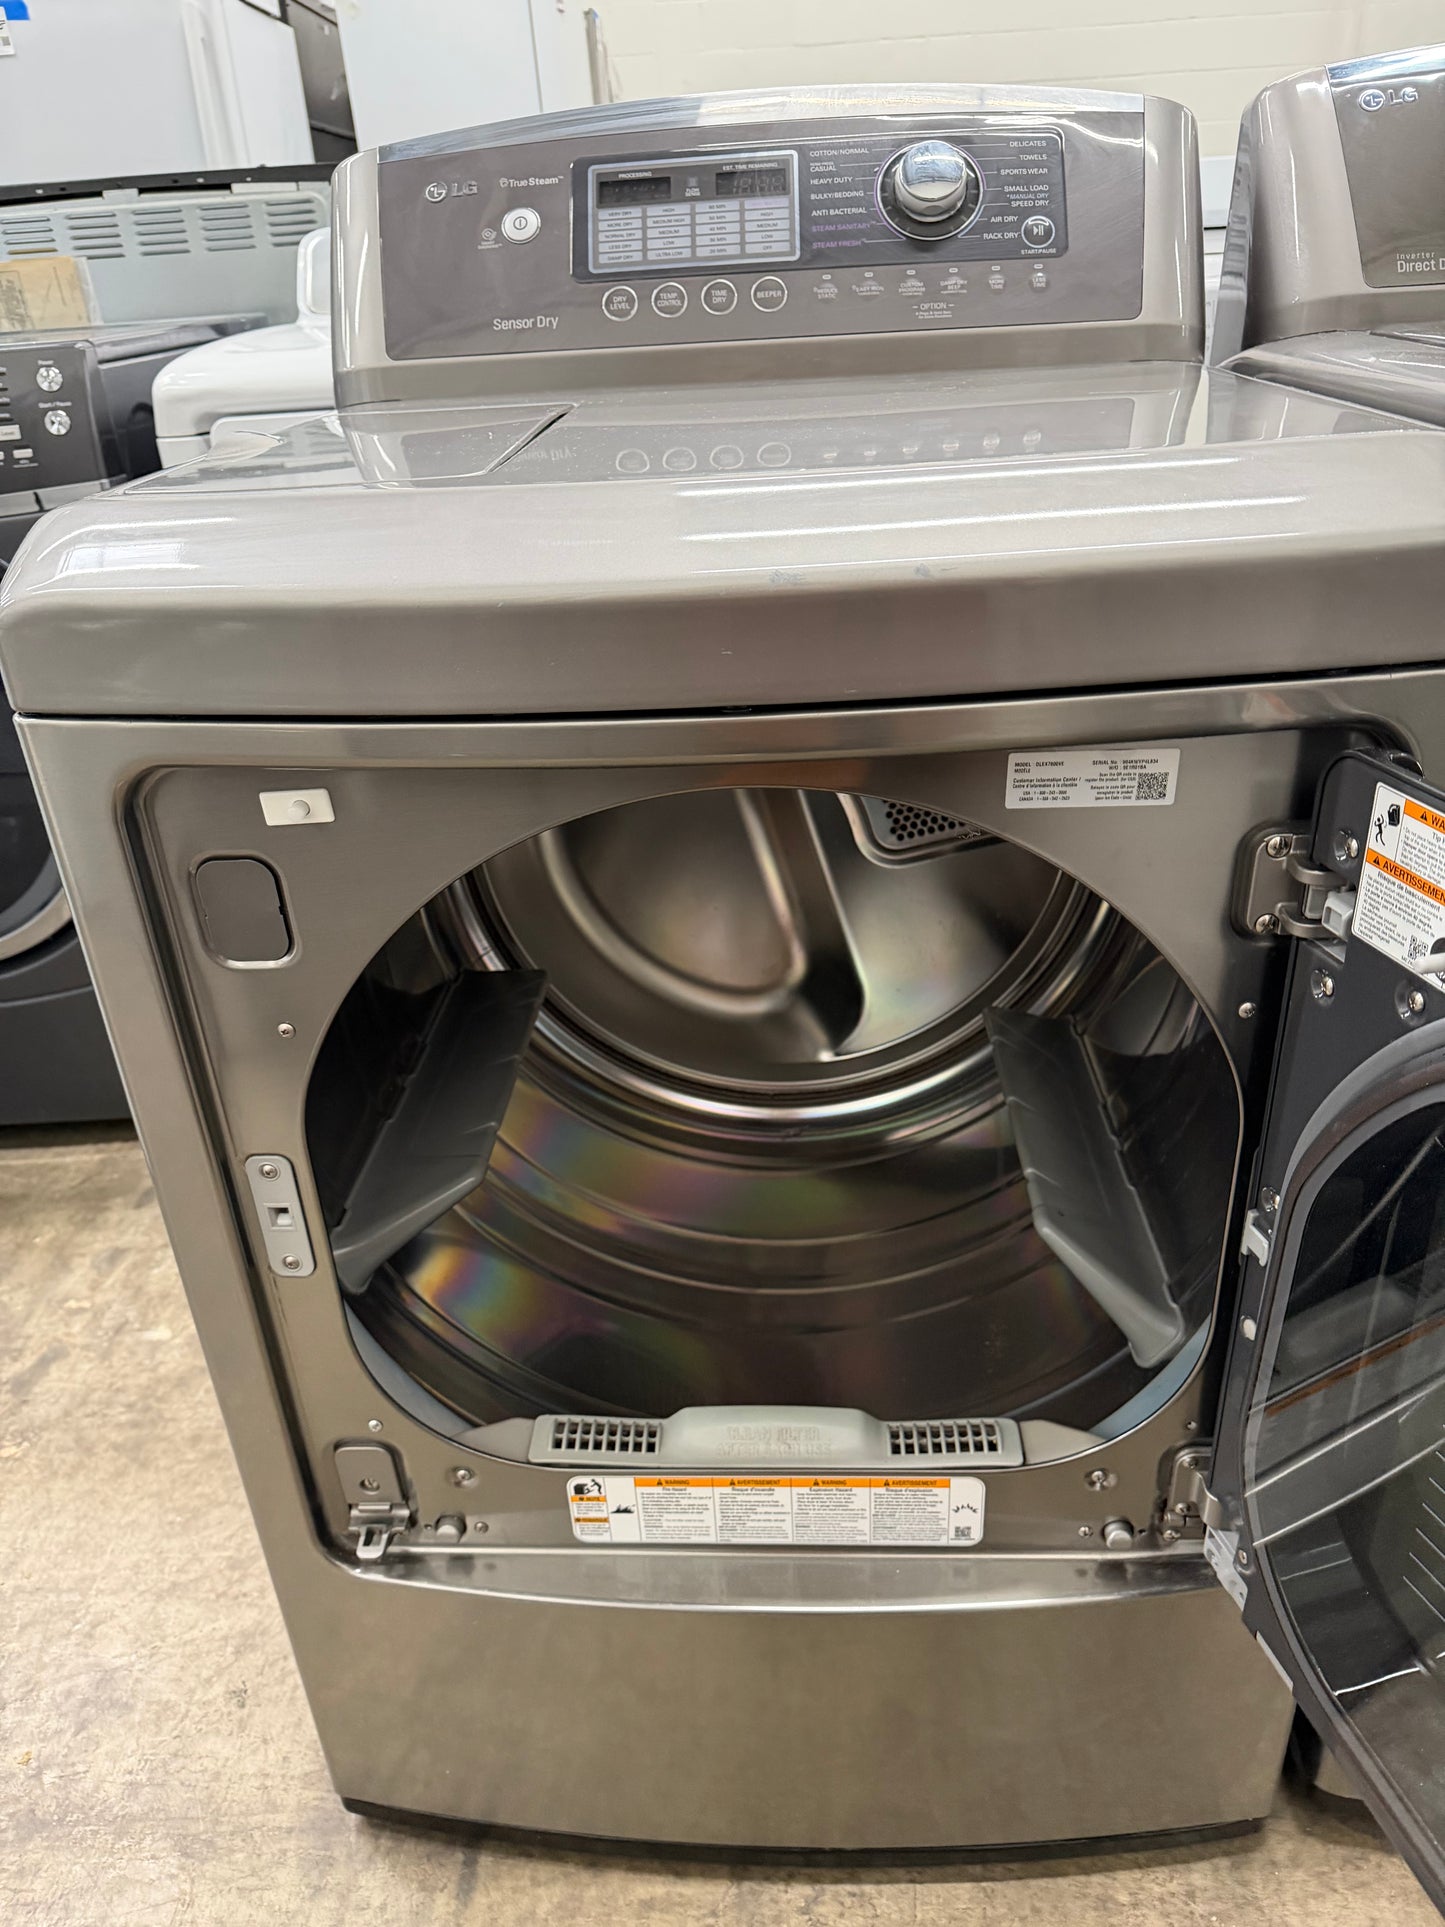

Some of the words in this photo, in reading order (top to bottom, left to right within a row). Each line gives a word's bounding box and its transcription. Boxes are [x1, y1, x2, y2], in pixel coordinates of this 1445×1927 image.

[1388, 87, 1418, 105] LG
[451, 180, 478, 197] LG
[810, 190, 864, 200] BULKY/BEDDING
[830, 207, 868, 215] BACTERIAL
[1396, 252, 1435, 260] Inverter
[1397, 260, 1436, 272] Direct
[757, 290, 782, 298] BEEPER
[920, 302, 947, 310] OPTION
[493, 318, 535, 330] Sensor
[536, 315, 559, 330] Dry
[1377, 870, 1396, 888] Risque
[1396, 881, 1404, 891] de
[1382, 860, 1445, 902] AVERTISSEMEN
